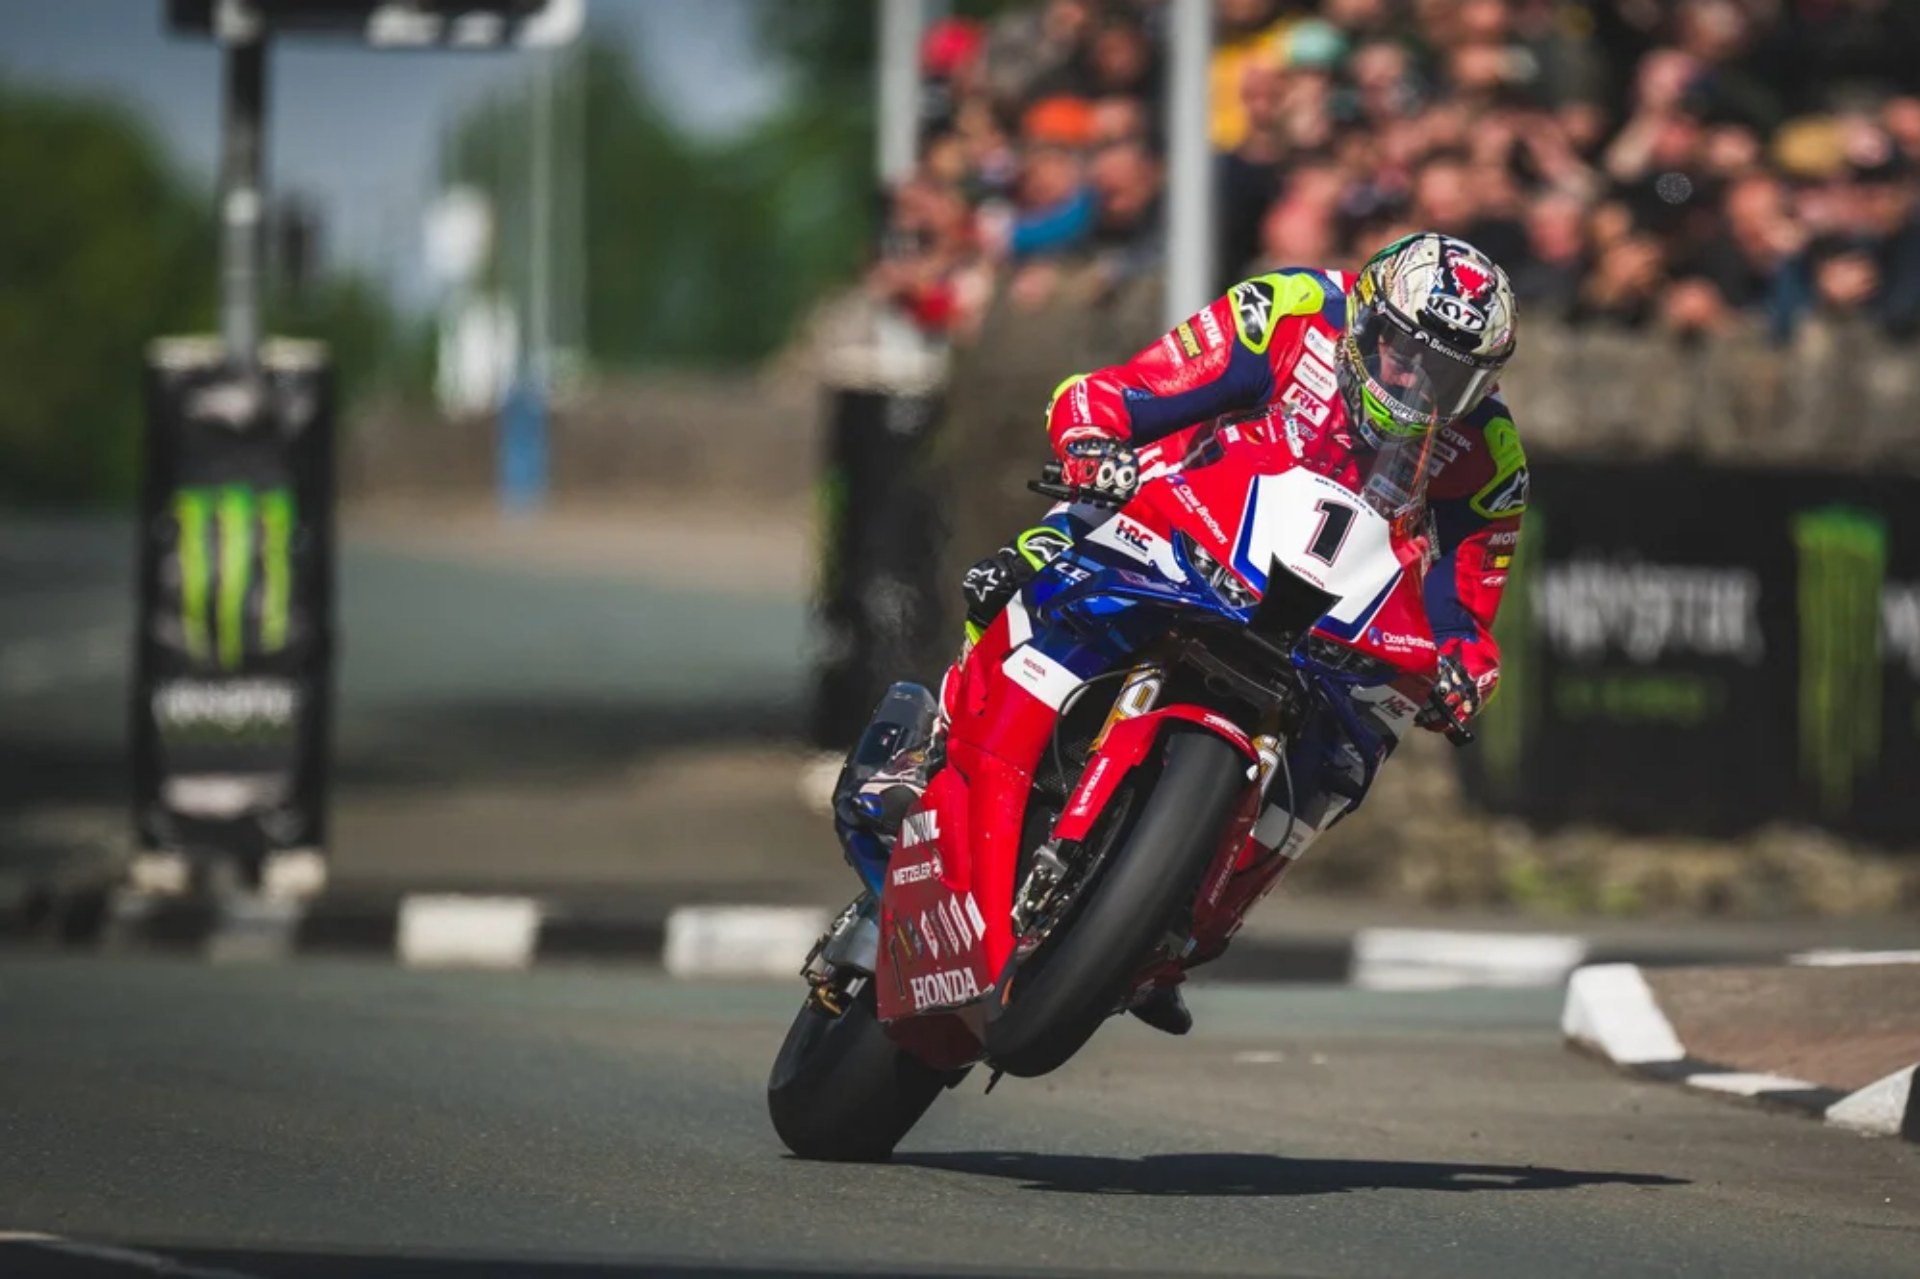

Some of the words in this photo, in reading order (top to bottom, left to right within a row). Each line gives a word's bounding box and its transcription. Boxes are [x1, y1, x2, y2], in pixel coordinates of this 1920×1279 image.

[1440, 427, 1473, 452] OTUL
[1115, 519, 1153, 552] HRC
[1196, 505, 1228, 544] Brothers
[1304, 498, 1358, 568] 1
[1489, 531, 1519, 546] MOT
[1291, 563, 1325, 588] HONDA
[893, 861, 931, 886] METZELER
[910, 966, 980, 1010] HONDA
